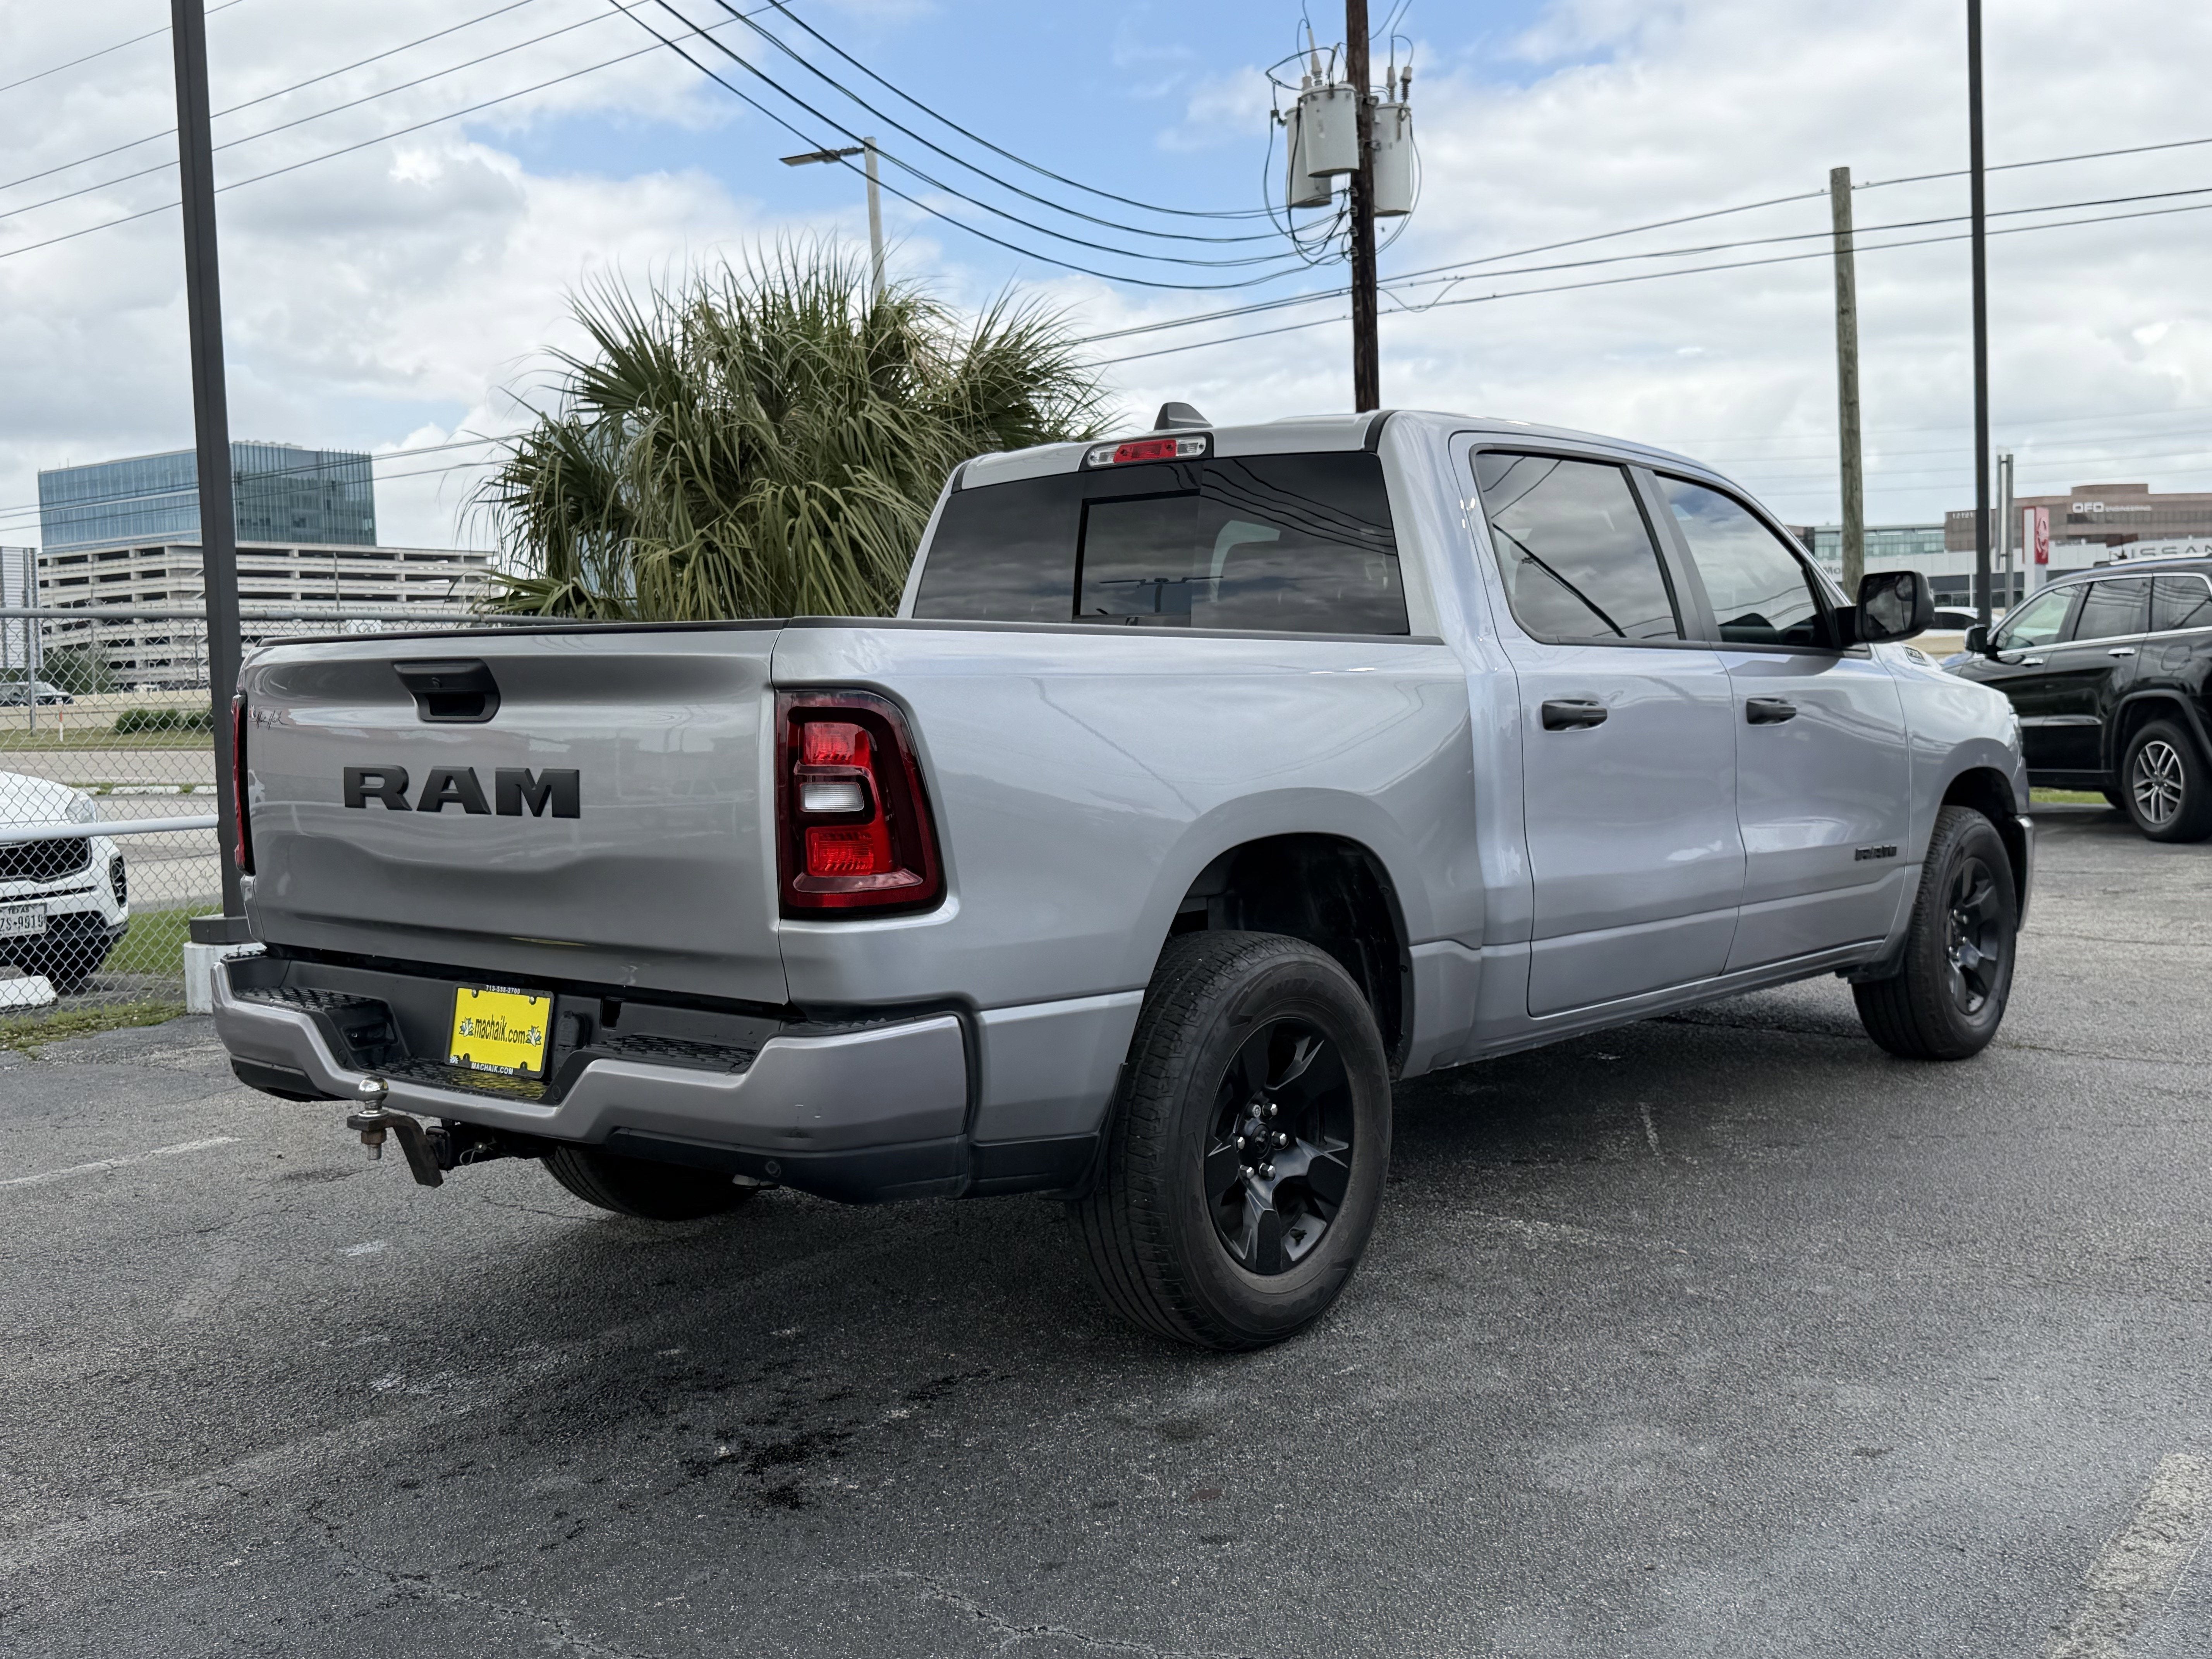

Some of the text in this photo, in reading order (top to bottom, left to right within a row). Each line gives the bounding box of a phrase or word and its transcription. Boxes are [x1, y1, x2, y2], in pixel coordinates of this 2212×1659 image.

[344, 765, 580, 818] RAM
[486, 985, 520, 994] 713-538-2700
[474, 1014, 526, 1044] machaik.com
[471, 1062, 514, 1075] MACHAIK.COM
